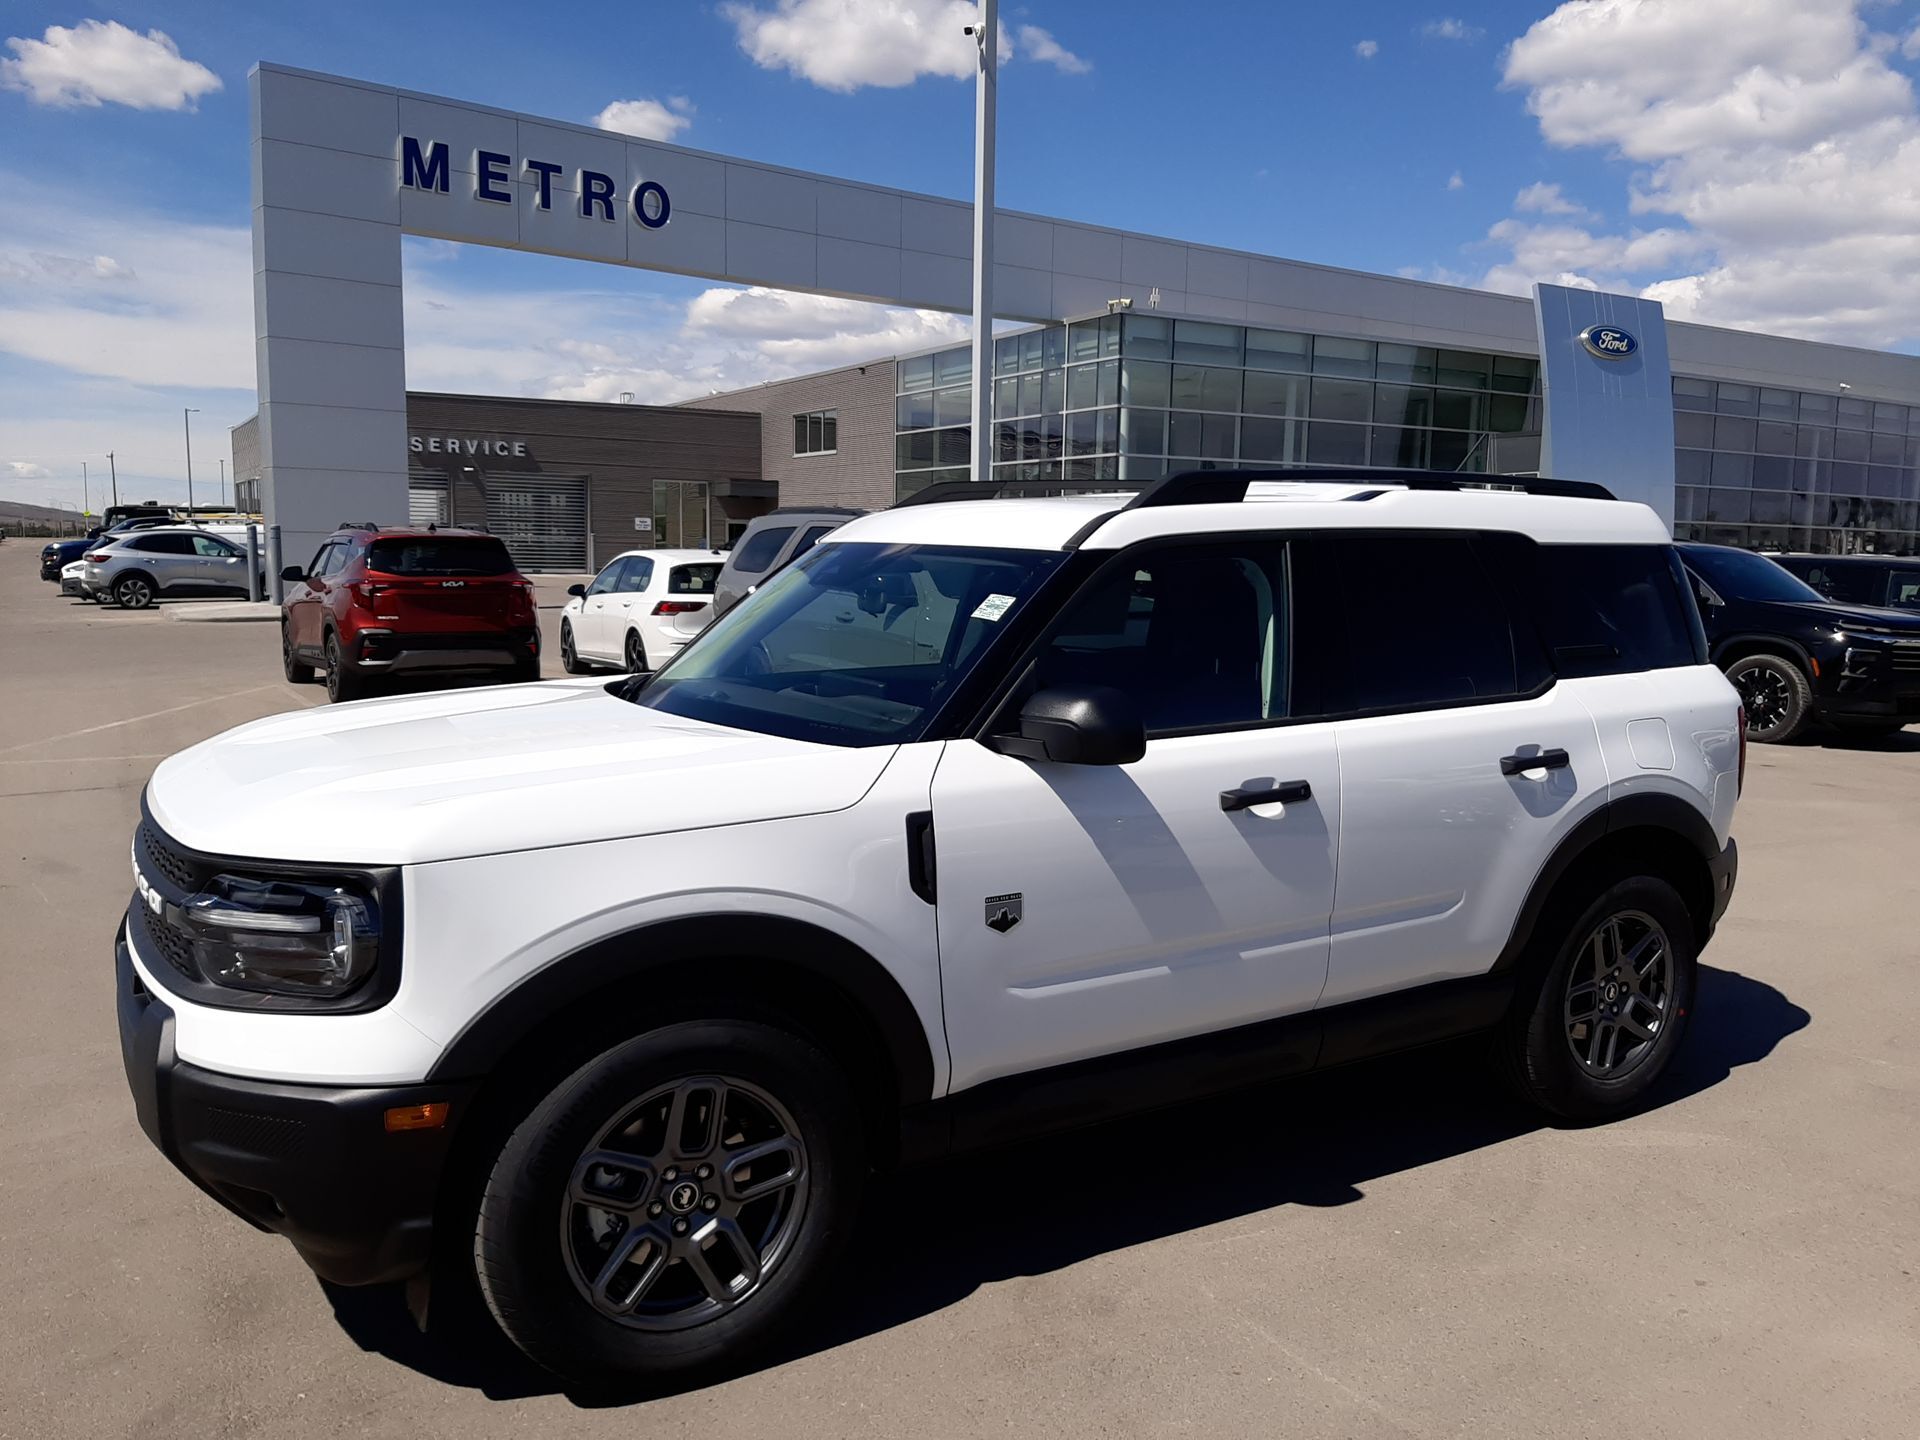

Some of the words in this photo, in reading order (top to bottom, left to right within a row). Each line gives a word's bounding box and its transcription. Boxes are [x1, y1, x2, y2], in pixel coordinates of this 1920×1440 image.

[400, 135, 671, 229] METRO
[1598, 331, 1628, 351] Ford
[409, 436, 526, 457] SERVICE
